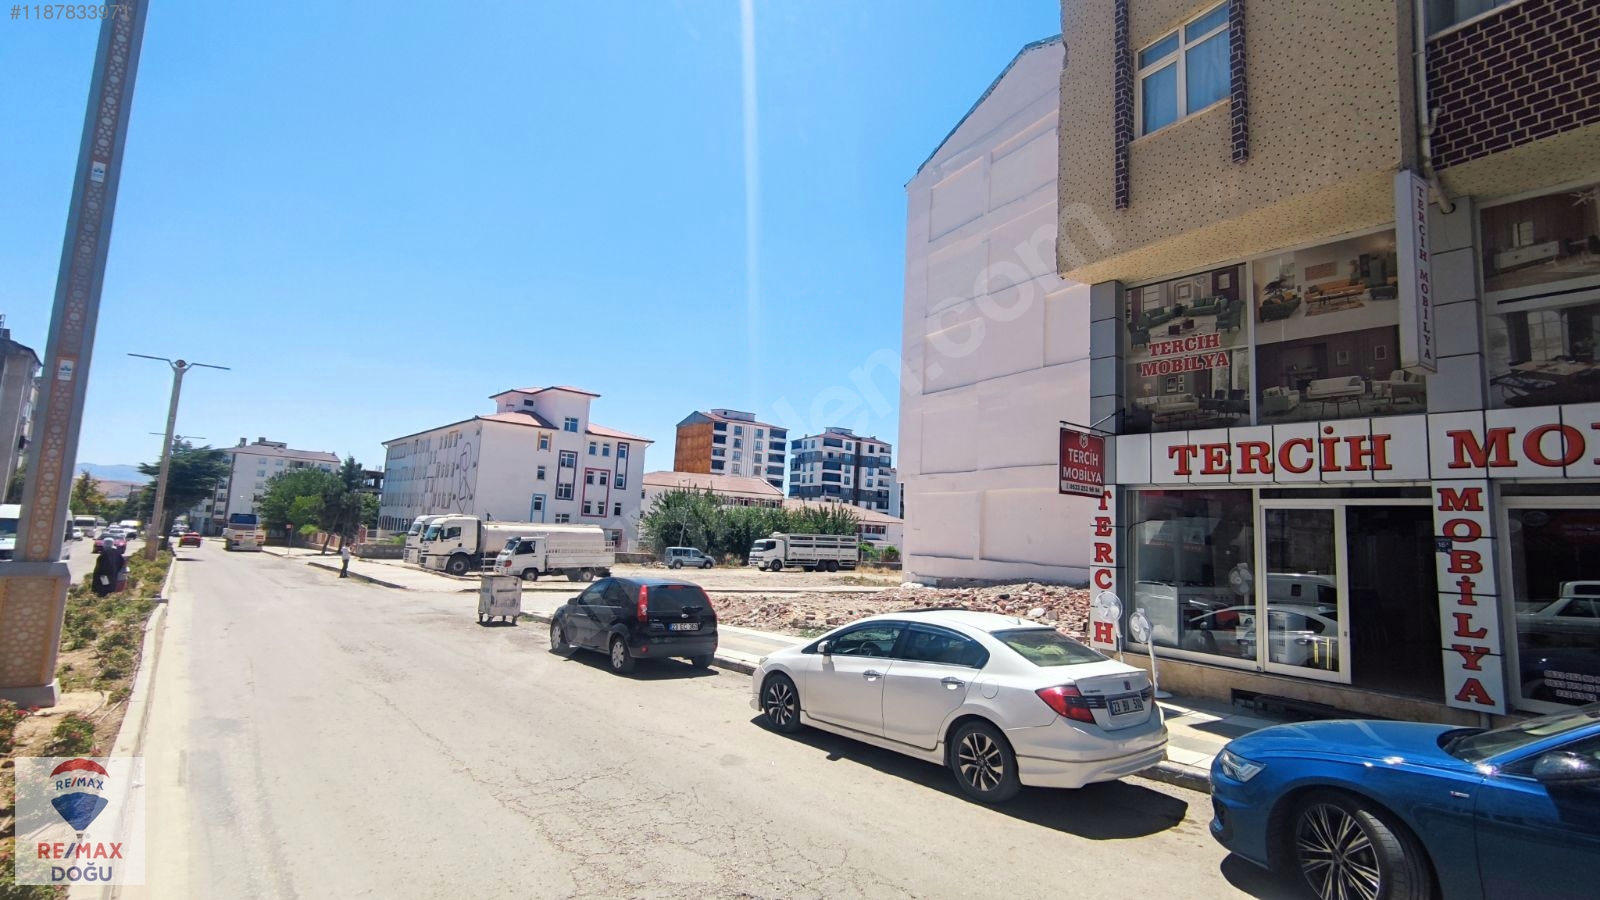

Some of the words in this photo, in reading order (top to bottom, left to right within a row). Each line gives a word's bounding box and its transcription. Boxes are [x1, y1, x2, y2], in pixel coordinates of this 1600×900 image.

[1148, 332, 1221, 357] TERCİH
[1141, 351, 1230, 378] MOBİLYA
[1067, 448, 1099, 467] TERCİH
[1168, 425, 1392, 475] TERCİH
[1447, 423, 1600, 469] MO
[1062, 466, 1102, 484] MOBİLYA
[1094, 490, 1113, 644] TERCH
[1436, 487, 1495, 706] MOBİLYA
